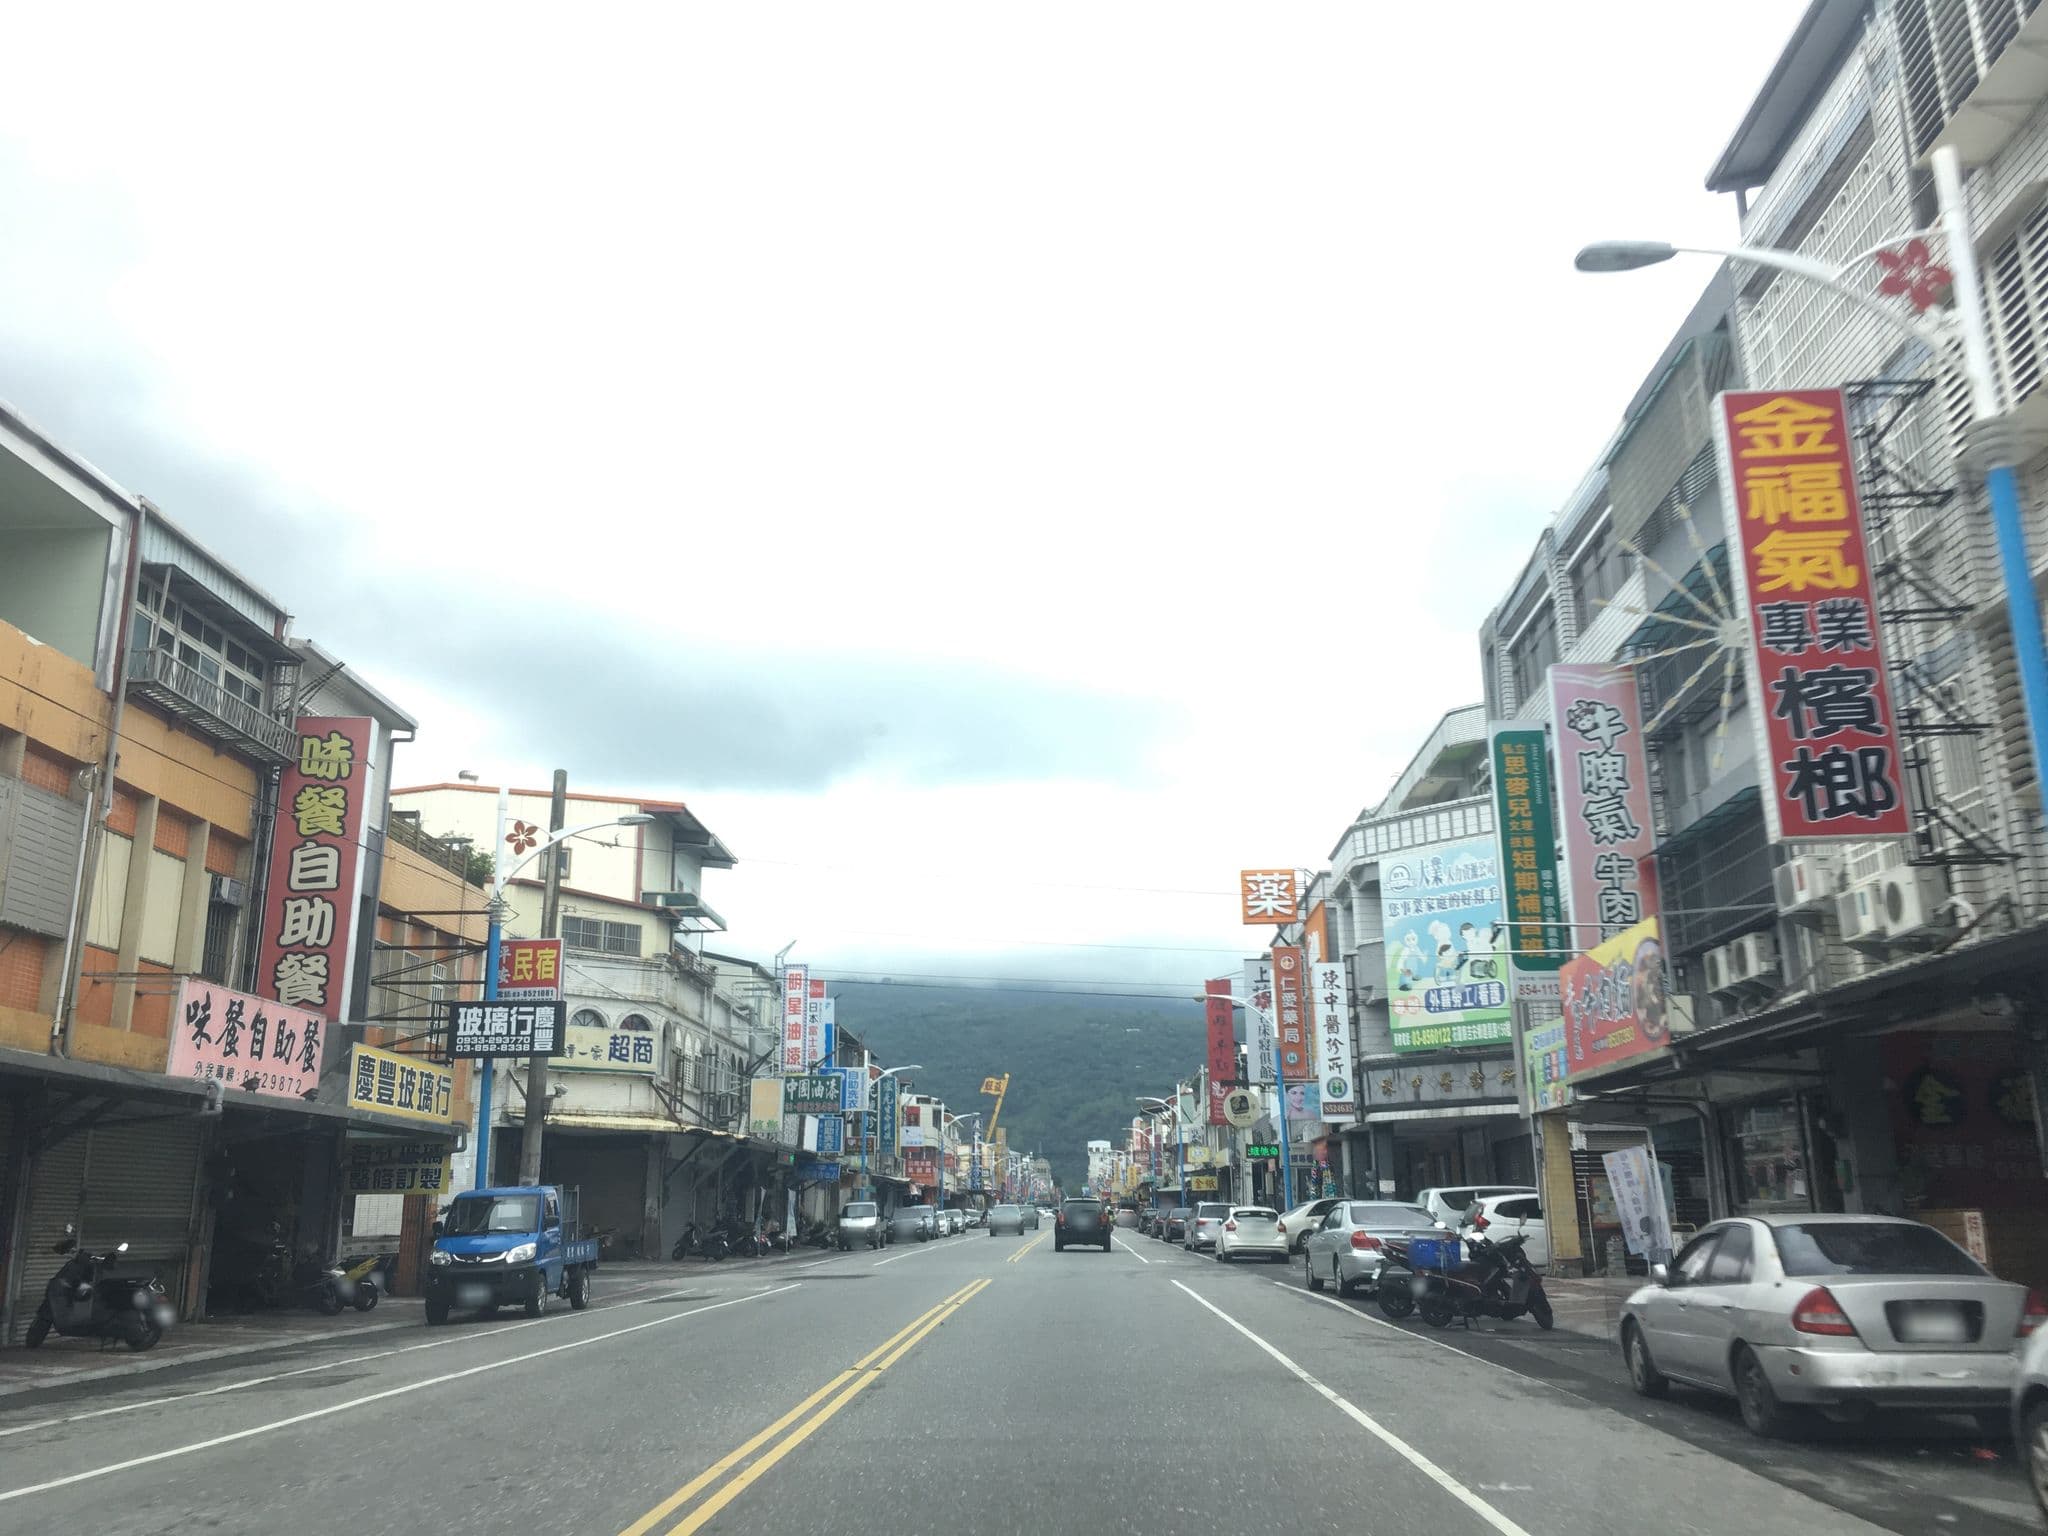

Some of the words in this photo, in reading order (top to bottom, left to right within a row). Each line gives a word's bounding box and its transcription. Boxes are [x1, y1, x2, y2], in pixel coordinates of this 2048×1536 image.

[1733, 396, 1860, 593] 金福氣
[1756, 598, 1874, 654] 專業
[1567, 700, 1639, 845] 牛脾氣
[1774, 664, 1897, 823] 檳榔
[275, 731, 353, 1005] 味餐自助餐
[1512, 850, 1546, 957] 短期補習班
[512, 947, 558, 981] 民宿
[1519, 984, 1561, 995] 854-113
[187, 990, 320, 1074] 味餐自助餐
[457, 1006, 534, 1036] 玻璃行
[608, 1033, 654, 1064] 超商
[1322, 970, 1344, 1075] 陳中醫診所
[354, 1053, 452, 1117] 慶豐玻璃行
[786, 1078, 840, 1101] 中國油漆
